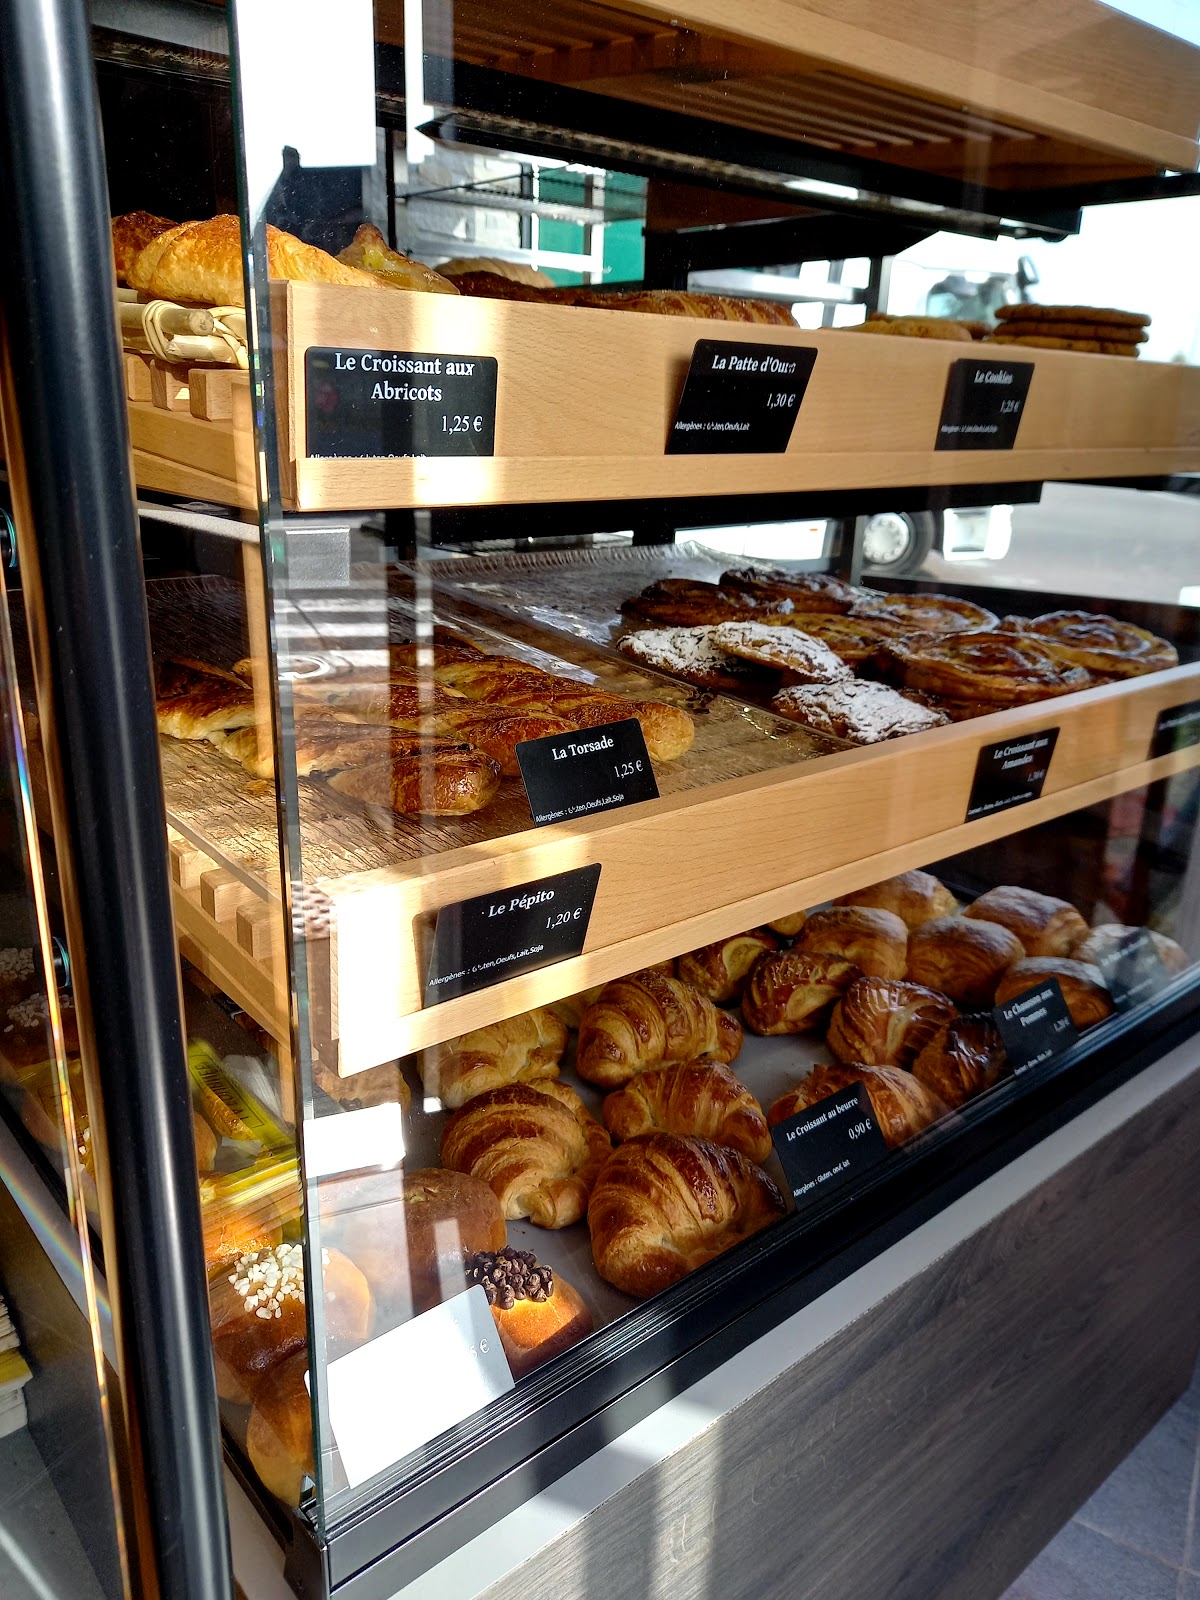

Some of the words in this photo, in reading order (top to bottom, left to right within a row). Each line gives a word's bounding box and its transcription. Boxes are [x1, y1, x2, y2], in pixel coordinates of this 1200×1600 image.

[335, 352, 356, 371] Le
[361, 354, 442, 376] Croissant
[446, 362, 475, 377] aux
[712, 354, 727, 371] La
[728, 355, 759, 372] Patte
[974, 369, 985, 384] Le
[371, 380, 443, 402] Abricots
[766, 393, 787, 410] 1,30
[787, 393, 796, 408] €
[441, 415, 470, 435] 1,25
[473, 415, 483, 432] €
[552, 747, 568, 761] La
[568, 735, 614, 757] Torsade
[614, 762, 635, 779] 1,25
[635, 760, 644, 772] €
[488, 905, 505, 918] Le
[508, 889, 555, 912] Pépito
[545, 911, 571, 930] 1,20
[573, 907, 583, 920] €
[1003, 1010, 1014, 1020] Le
[786, 1131, 797, 1142] Le
[796, 1113, 828, 1136] Croissant
[827, 1110, 838, 1119] au
[835, 1097, 859, 1114] beurre
[848, 1121, 866, 1140] 0,90
[865, 1118, 873, 1131] €
